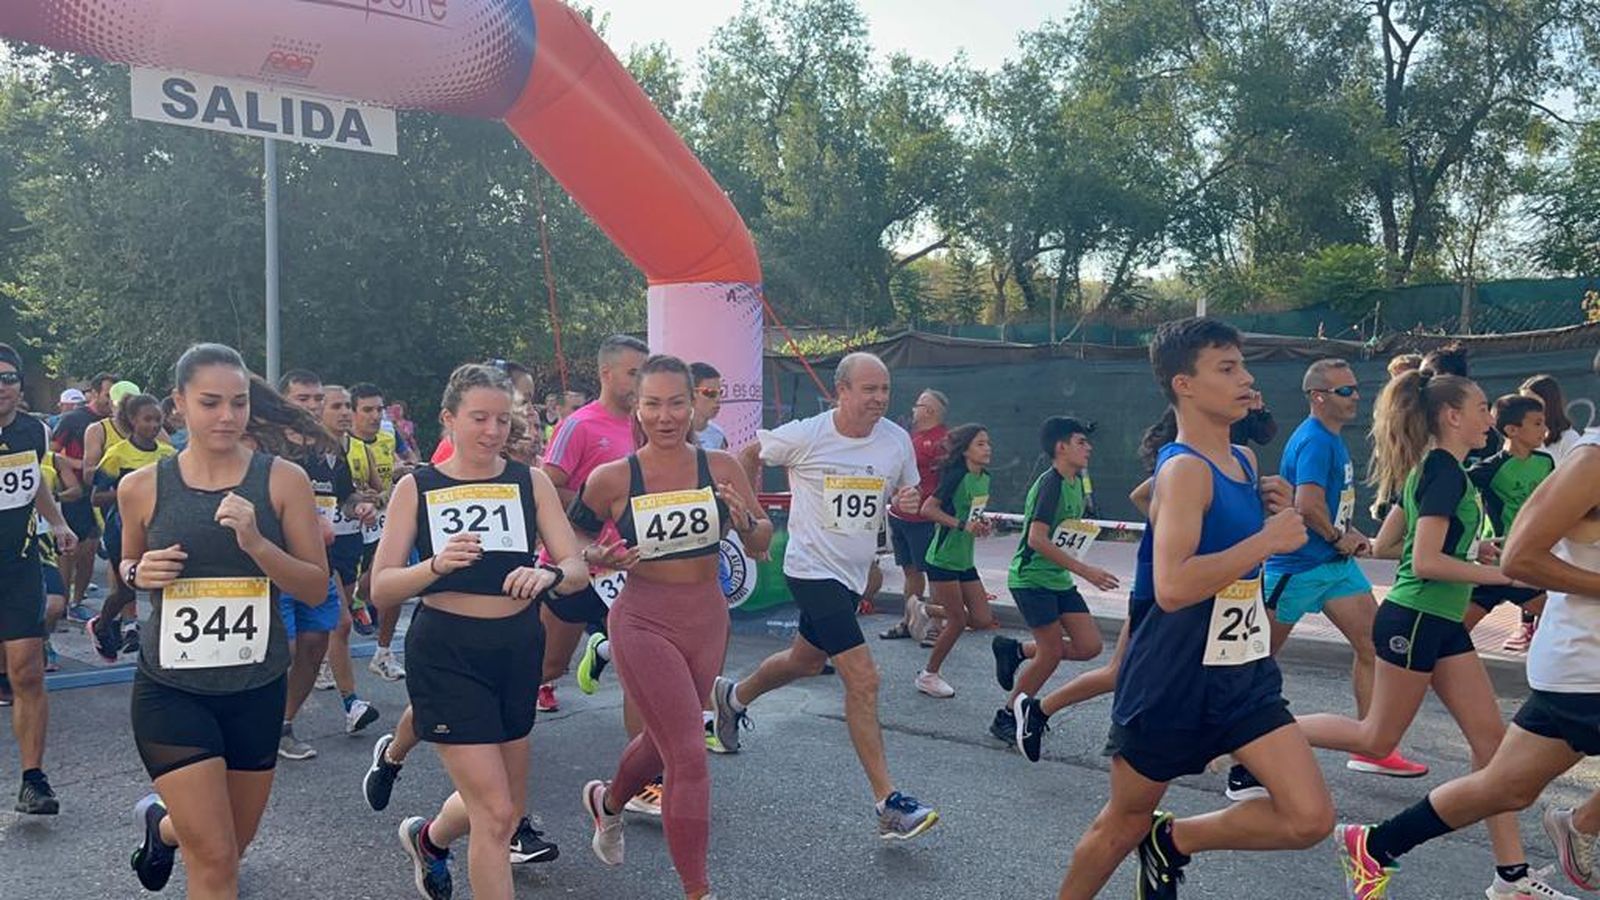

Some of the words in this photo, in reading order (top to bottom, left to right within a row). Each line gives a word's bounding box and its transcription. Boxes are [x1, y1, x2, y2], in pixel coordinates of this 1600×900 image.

[161, 77, 372, 147] SALIDA
[0, 468, 34, 494] 95
[440, 504, 510, 535] 321
[832, 494, 877, 518] 195
[646, 507, 710, 542] 428
[1055, 531, 1087, 550] 541
[174, 604, 258, 643] 344
